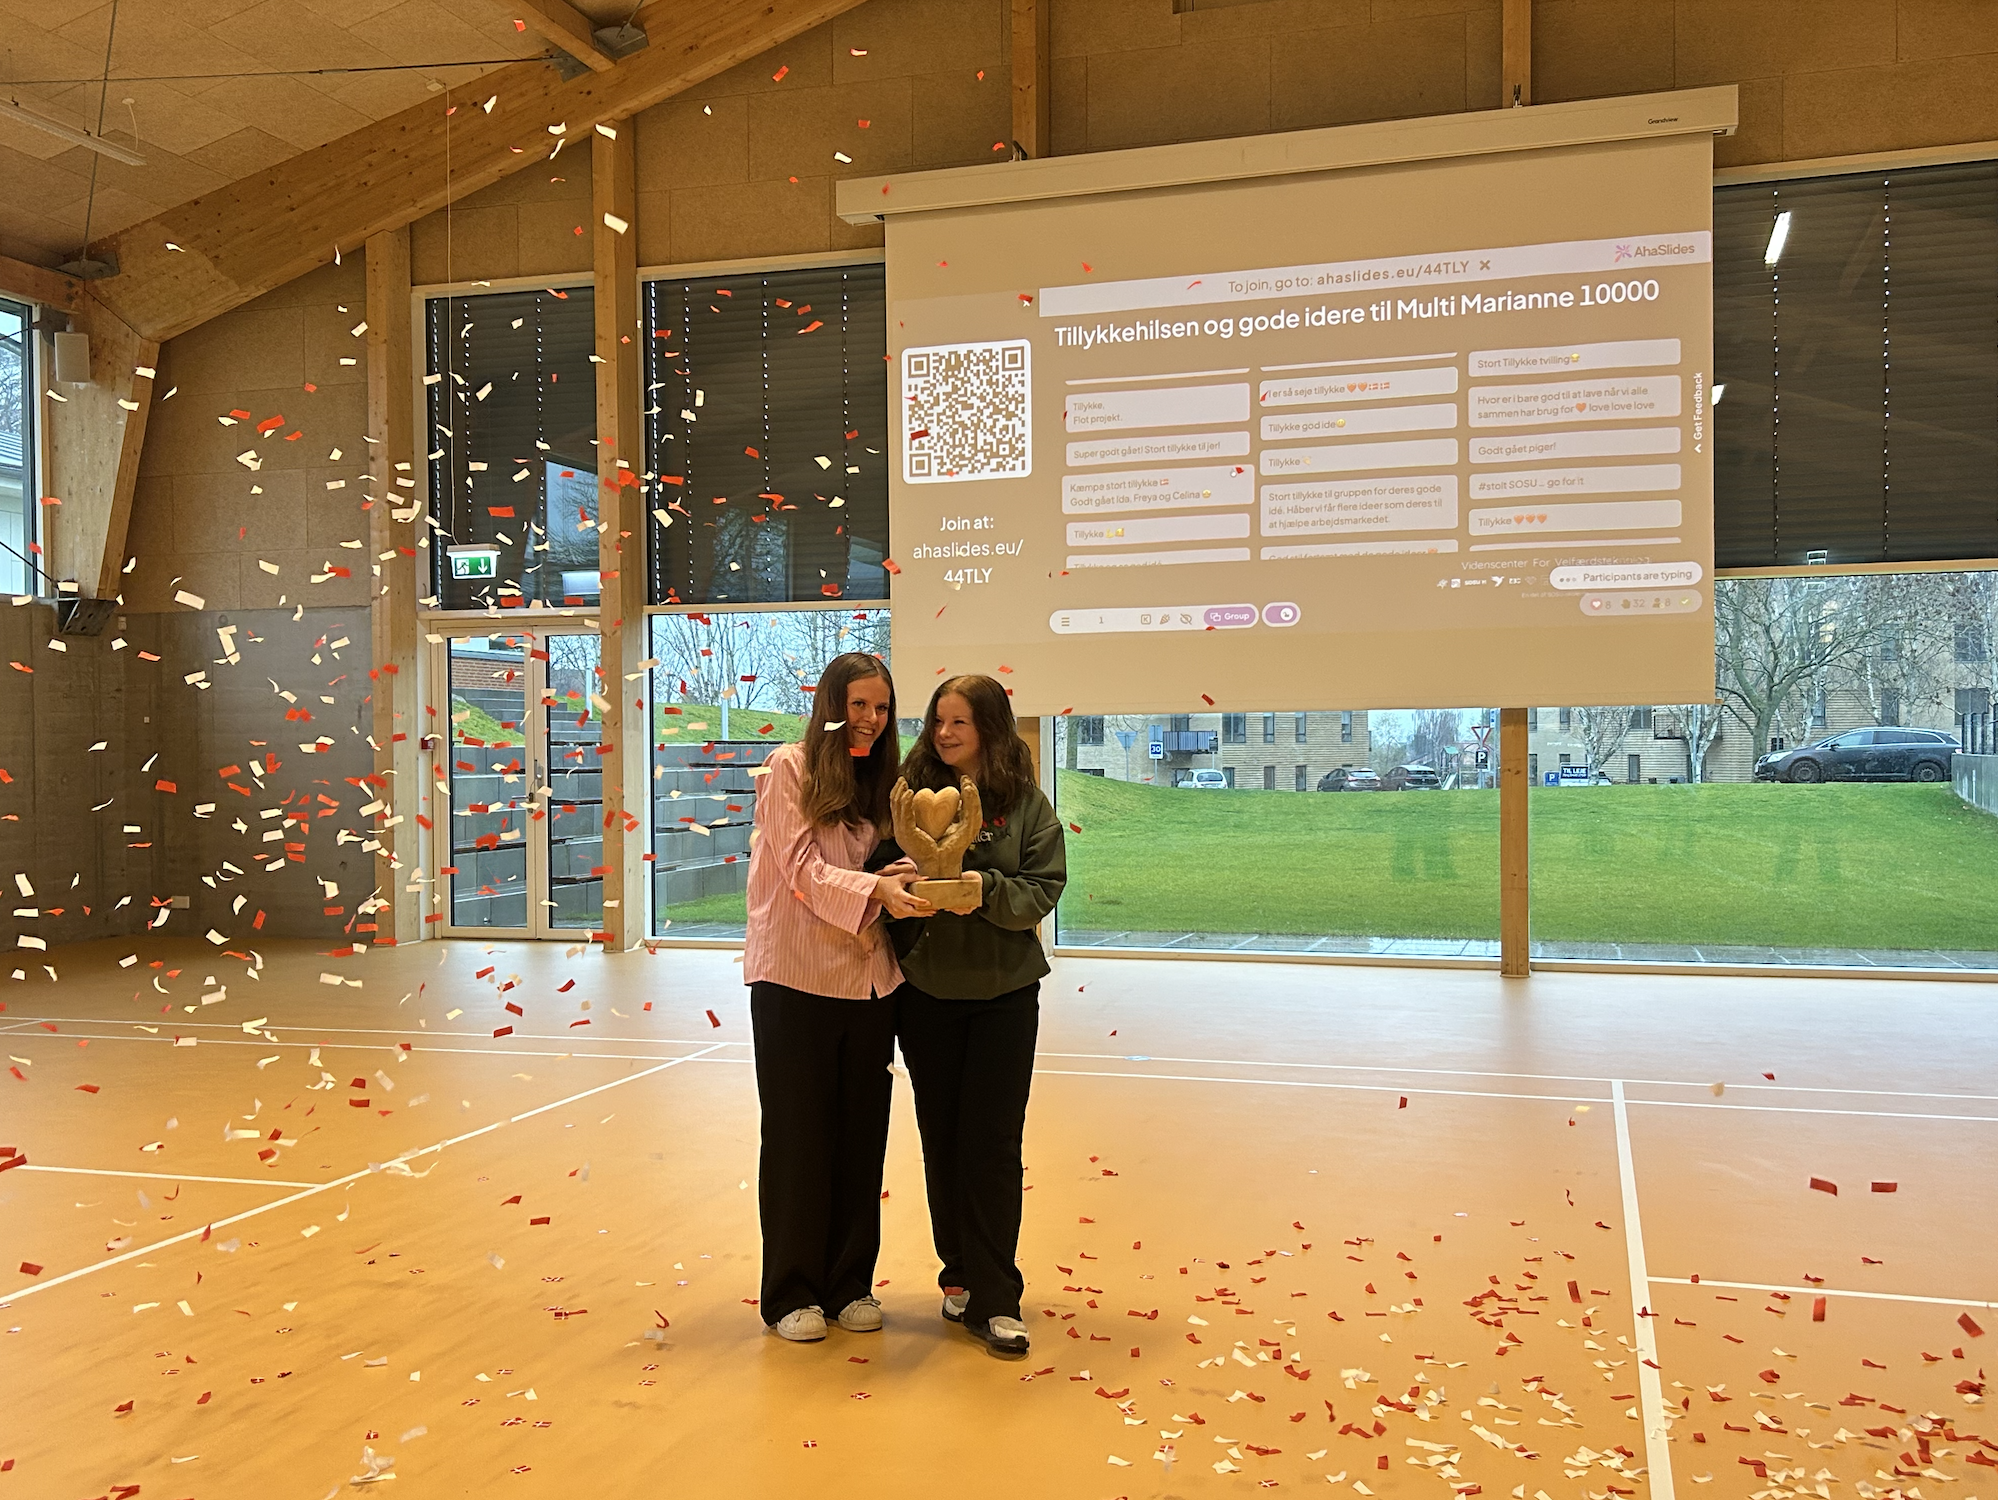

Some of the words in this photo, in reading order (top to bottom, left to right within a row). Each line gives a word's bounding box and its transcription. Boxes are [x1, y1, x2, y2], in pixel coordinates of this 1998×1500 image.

[1634, 244, 1695, 258] AhaSlides
[1228, 280, 1242, 294] To
[1243, 278, 1272, 295] join,
[1275, 278, 1292, 292] go
[1295, 276, 1312, 288] to:
[1317, 260, 1470, 286] ahaslides.eu/44TLY
[1054, 320, 1199, 350] Tillykkehilsen
[1204, 316, 1234, 338] og
[1238, 309, 1300, 338] gode
[1304, 306, 1365, 328] idere
[1370, 300, 1392, 322] til
[1397, 295, 1456, 320] Multi
[1461, 290, 1575, 315] Marianne
[1580, 280, 1660, 306] 10000
[1478, 359, 1501, 369] Stort
[1503, 357, 1538, 368] Tillykke
[1539, 355, 1570, 366] tvilling
[1282, 388, 1293, 396] så
[1294, 388, 1312, 398] seje
[1314, 385, 1346, 396] tillykke
[1478, 396, 1500, 404] Hvor
[1502, 396, 1512, 404] er
[1517, 393, 1539, 403] bare
[1540, 392, 1560, 404] god
[1562, 390, 1570, 400] til
[1572, 390, 1582, 399] at
[1582, 388, 1602, 398] lave
[1604, 386, 1620, 397] når
[1621, 387, 1630, 396] vi
[1630, 386, 1648, 396] alle
[1693, 372, 1702, 420] Feedback
[1478, 410, 1519, 419] sammen
[1520, 408, 1536, 418] har
[1536, 406, 1559, 417] brug
[1560, 405, 1574, 414] for
[1588, 403, 1610, 412] love
[1611, 402, 1632, 412] love
[1634, 401, 1654, 410] love
[1074, 416, 1090, 425] Flot
[1090, 414, 1122, 425] projekt.
[1268, 423, 1300, 433] Tillykke
[1302, 422, 1320, 432] god
[1322, 420, 1336, 429] ide
[1693, 422, 1702, 440] Get
[1074, 450, 1099, 460] Super
[1100, 448, 1121, 458] godt
[1122, 445, 1144, 457] gået!
[1144, 444, 1166, 454] Stort
[1166, 443, 1196, 454] tillykke
[1198, 442, 1206, 451] til
[1206, 441, 1221, 452] jer!
[1478, 445, 1504, 455] Godt
[1505, 444, 1527, 456] gået
[1528, 442, 1556, 454] piger!
[1268, 457, 1300, 468] Tillykke
[1070, 483, 1104, 494] Kæmpe
[1106, 480, 1126, 490] stort
[1128, 478, 1158, 490] tillykke
[1478, 480, 1507, 491] #stolt
[1508, 480, 1537, 490] SOSU
[1547, 478, 1560, 488] go
[1562, 476, 1576, 486] for
[1578, 476, 1584, 486] it
[1070, 498, 1094, 507] Godt
[1094, 495, 1116, 507] gået
[1133, 493, 1158, 504] Freya
[1158, 493, 1172, 502] og
[1172, 490, 1200, 500] Celina
[1268, 492, 1290, 502] Stort
[1292, 490, 1323, 502] tillykke
[1324, 489, 1333, 498] til
[1334, 489, 1372, 501] gruppen
[1374, 486, 1388, 496] for
[1388, 485, 1414, 494] deres
[1416, 484, 1442, 496] gode
[1268, 505, 1286, 516] idé.
[1286, 502, 1314, 514] Håber
[1315, 504, 1323, 513] vi
[1323, 502, 1336, 512] får
[1337, 502, 1358, 512] flere
[1359, 501, 1383, 511] ideer
[1384, 502, 1404, 510] som
[1406, 498, 1432, 508] deres
[1434, 498, 1443, 508] til
[940, 516, 970, 531] Join
[973, 516, 994, 530] at:
[1268, 520, 1278, 529] at
[1278, 518, 1310, 530] hjælpe
[1310, 515, 1390, 528] arbejdsmarkedet.
[1478, 517, 1512, 528] Tillykke
[1074, 530, 1104, 540] Tillykke
[912, 538, 1024, 559] ahaslides.eu/
[1461, 560, 1528, 570] Videnscenter
[1532, 558, 1550, 568] For
[944, 568, 993, 584] 44TLY
[1583, 572, 1641, 582] Participants
[1643, 572, 1658, 580] are
[1660, 570, 1692, 581] typing
[1224, 612, 1250, 622] Group
[1151, 745, 1161, 753] 30
[1478, 752, 1486, 762] P
